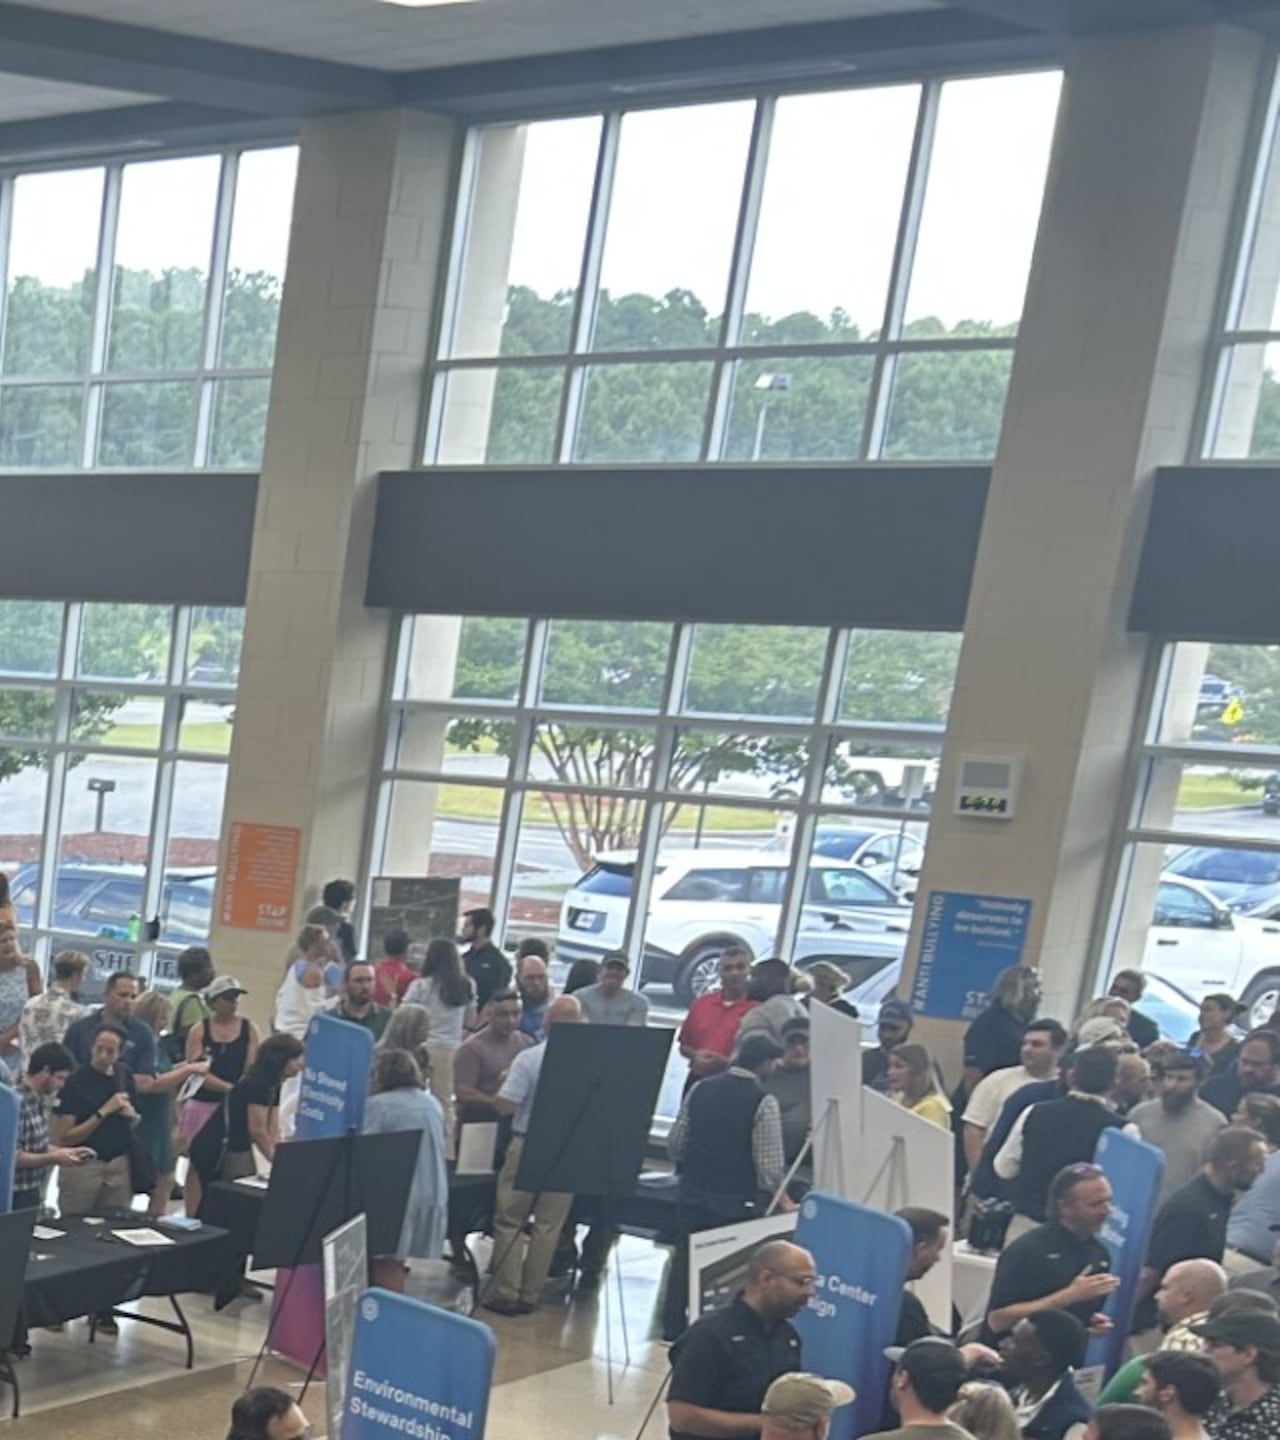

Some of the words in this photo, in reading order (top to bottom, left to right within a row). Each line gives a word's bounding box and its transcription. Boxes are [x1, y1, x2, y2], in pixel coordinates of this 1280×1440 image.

[807, 1295, 837, 1317] sign
[827, 1275, 877, 1307] Center
[353, 1370, 473, 1429] Environmental
